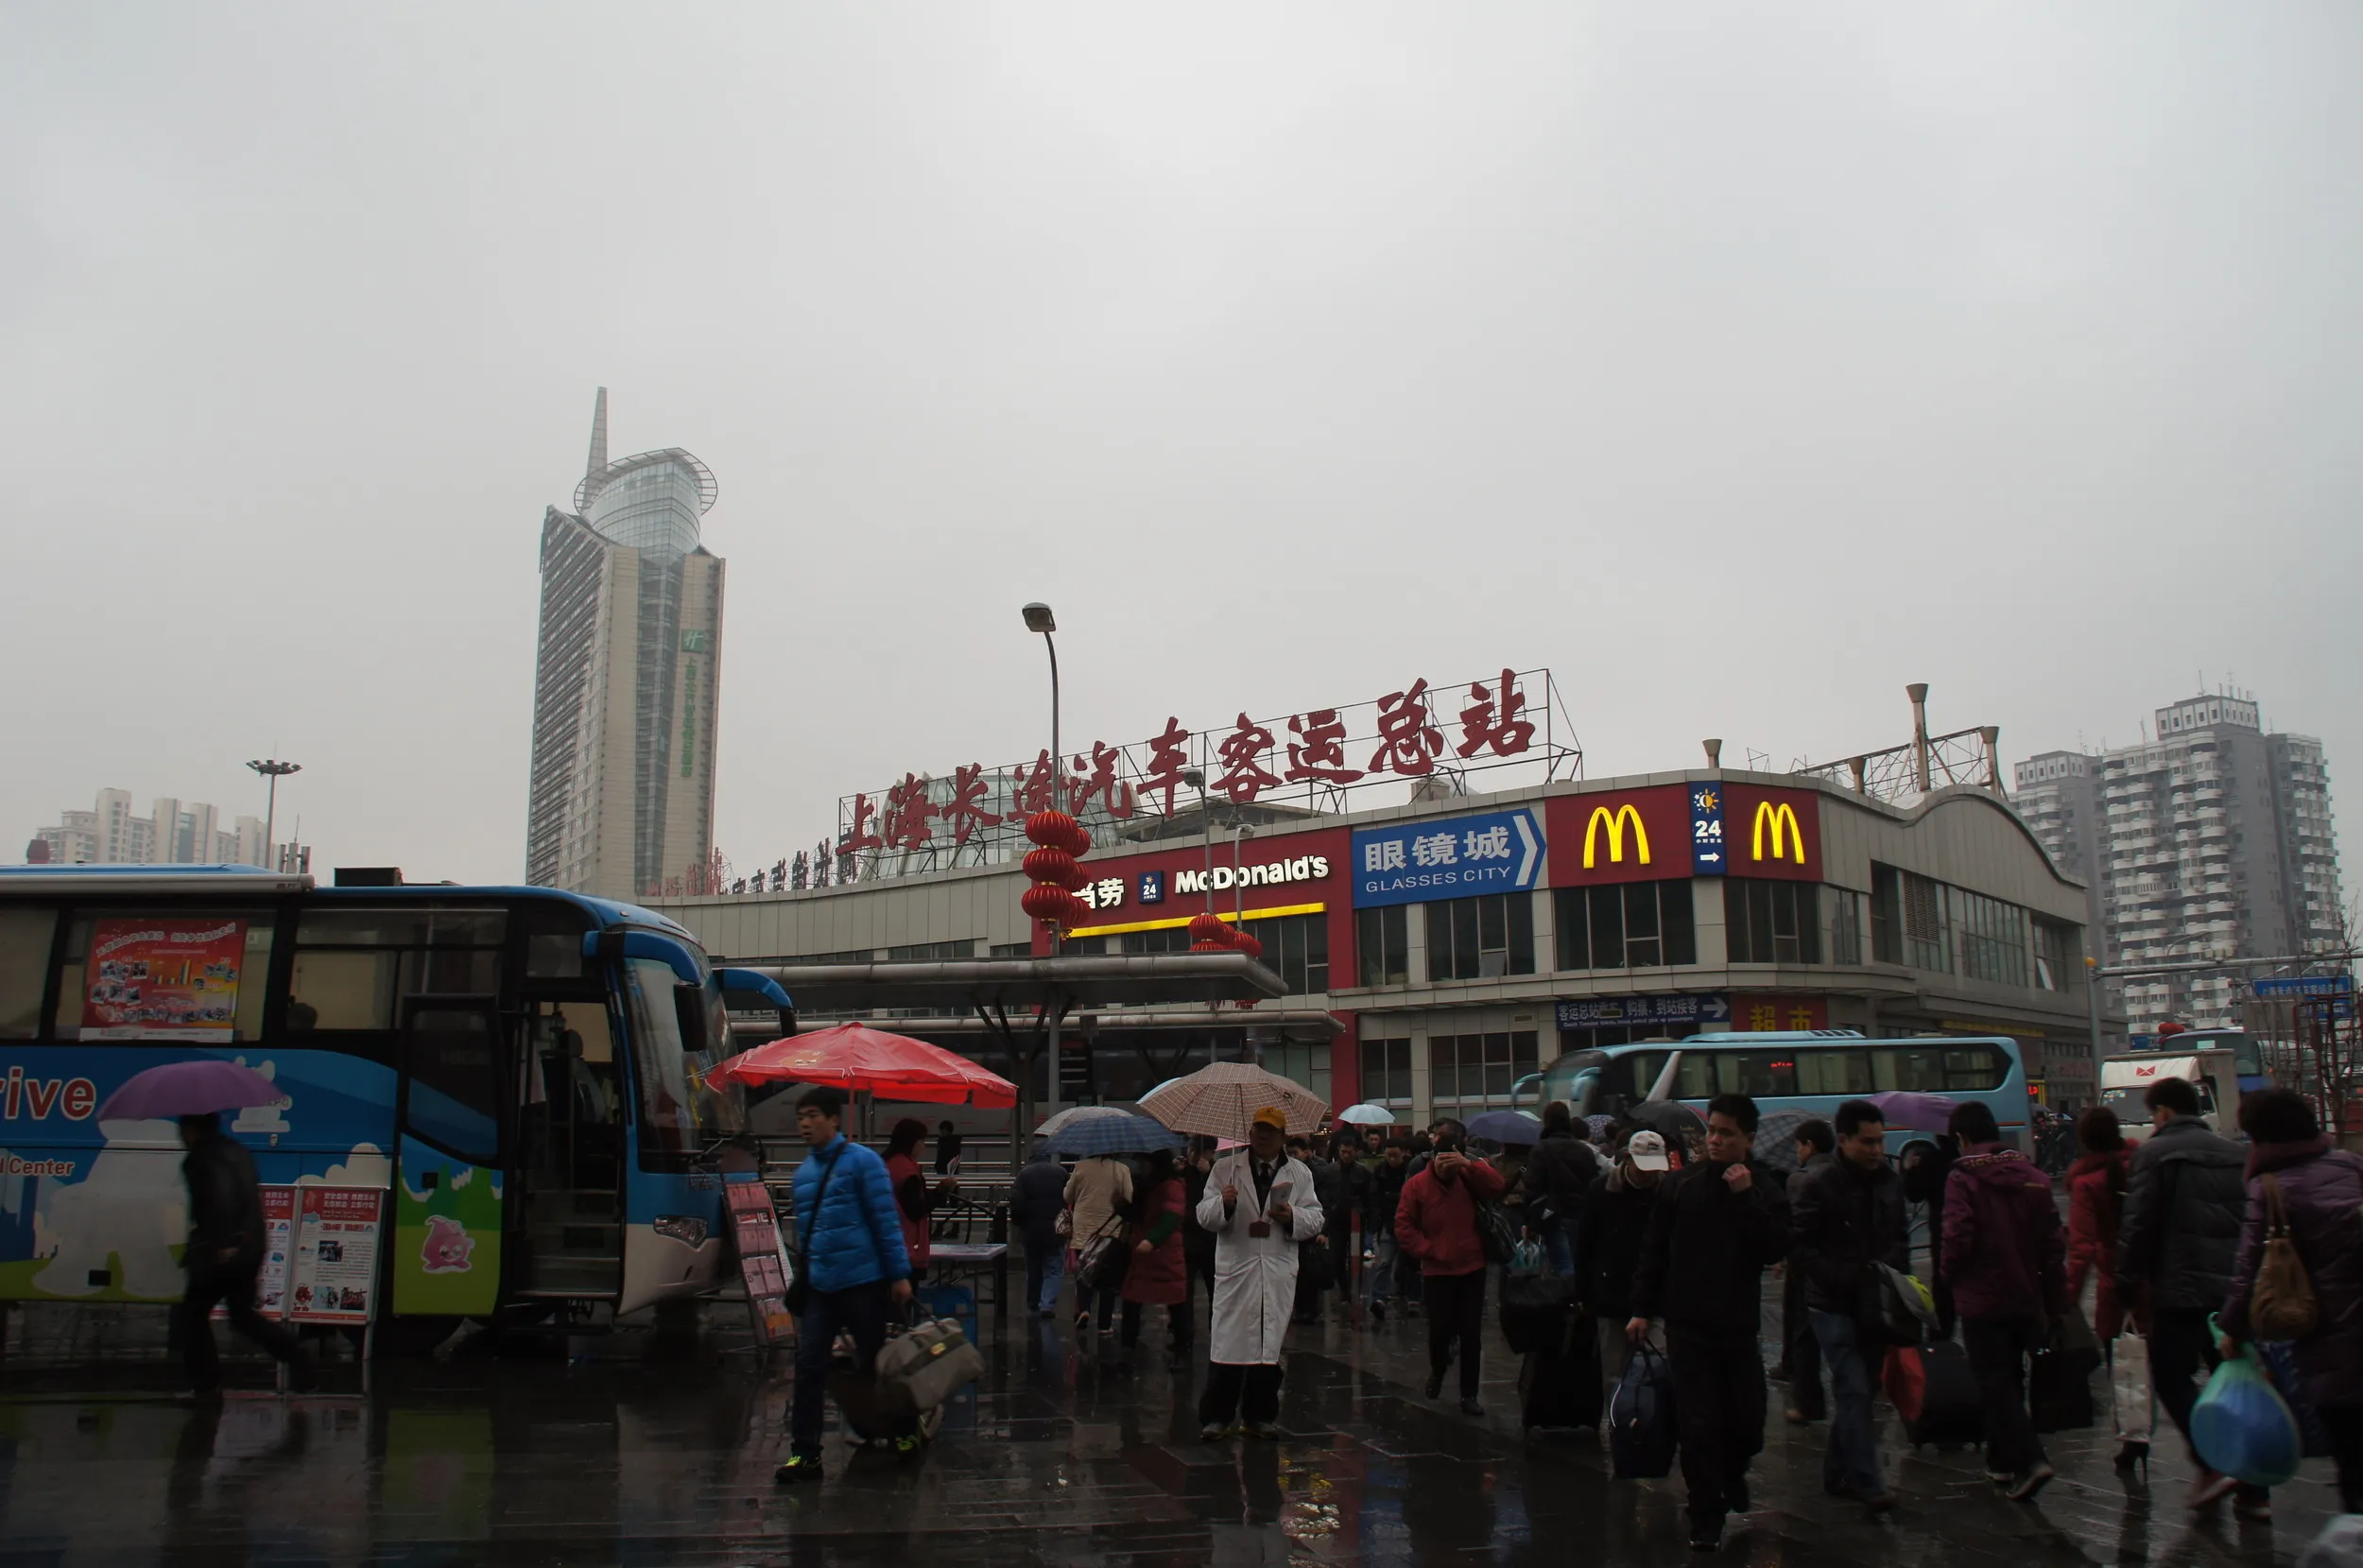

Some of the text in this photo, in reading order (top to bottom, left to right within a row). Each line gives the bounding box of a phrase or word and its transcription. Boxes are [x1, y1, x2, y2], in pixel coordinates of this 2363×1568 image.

[836, 667, 1538, 857] 上海长途汽车客运总站
[1695, 819, 1721, 838] 24
[1365, 825, 1511, 872] 眼镜城
[1175, 853, 1329, 895] McDonald's
[1365, 866, 1511, 894] GLASSES CITY
[1143, 883, 1157, 895] 24
[1749, 1005, 1813, 1031] 超市
[0, 1066, 96, 1121] ive
[8, 1157, 75, 1177] Center
